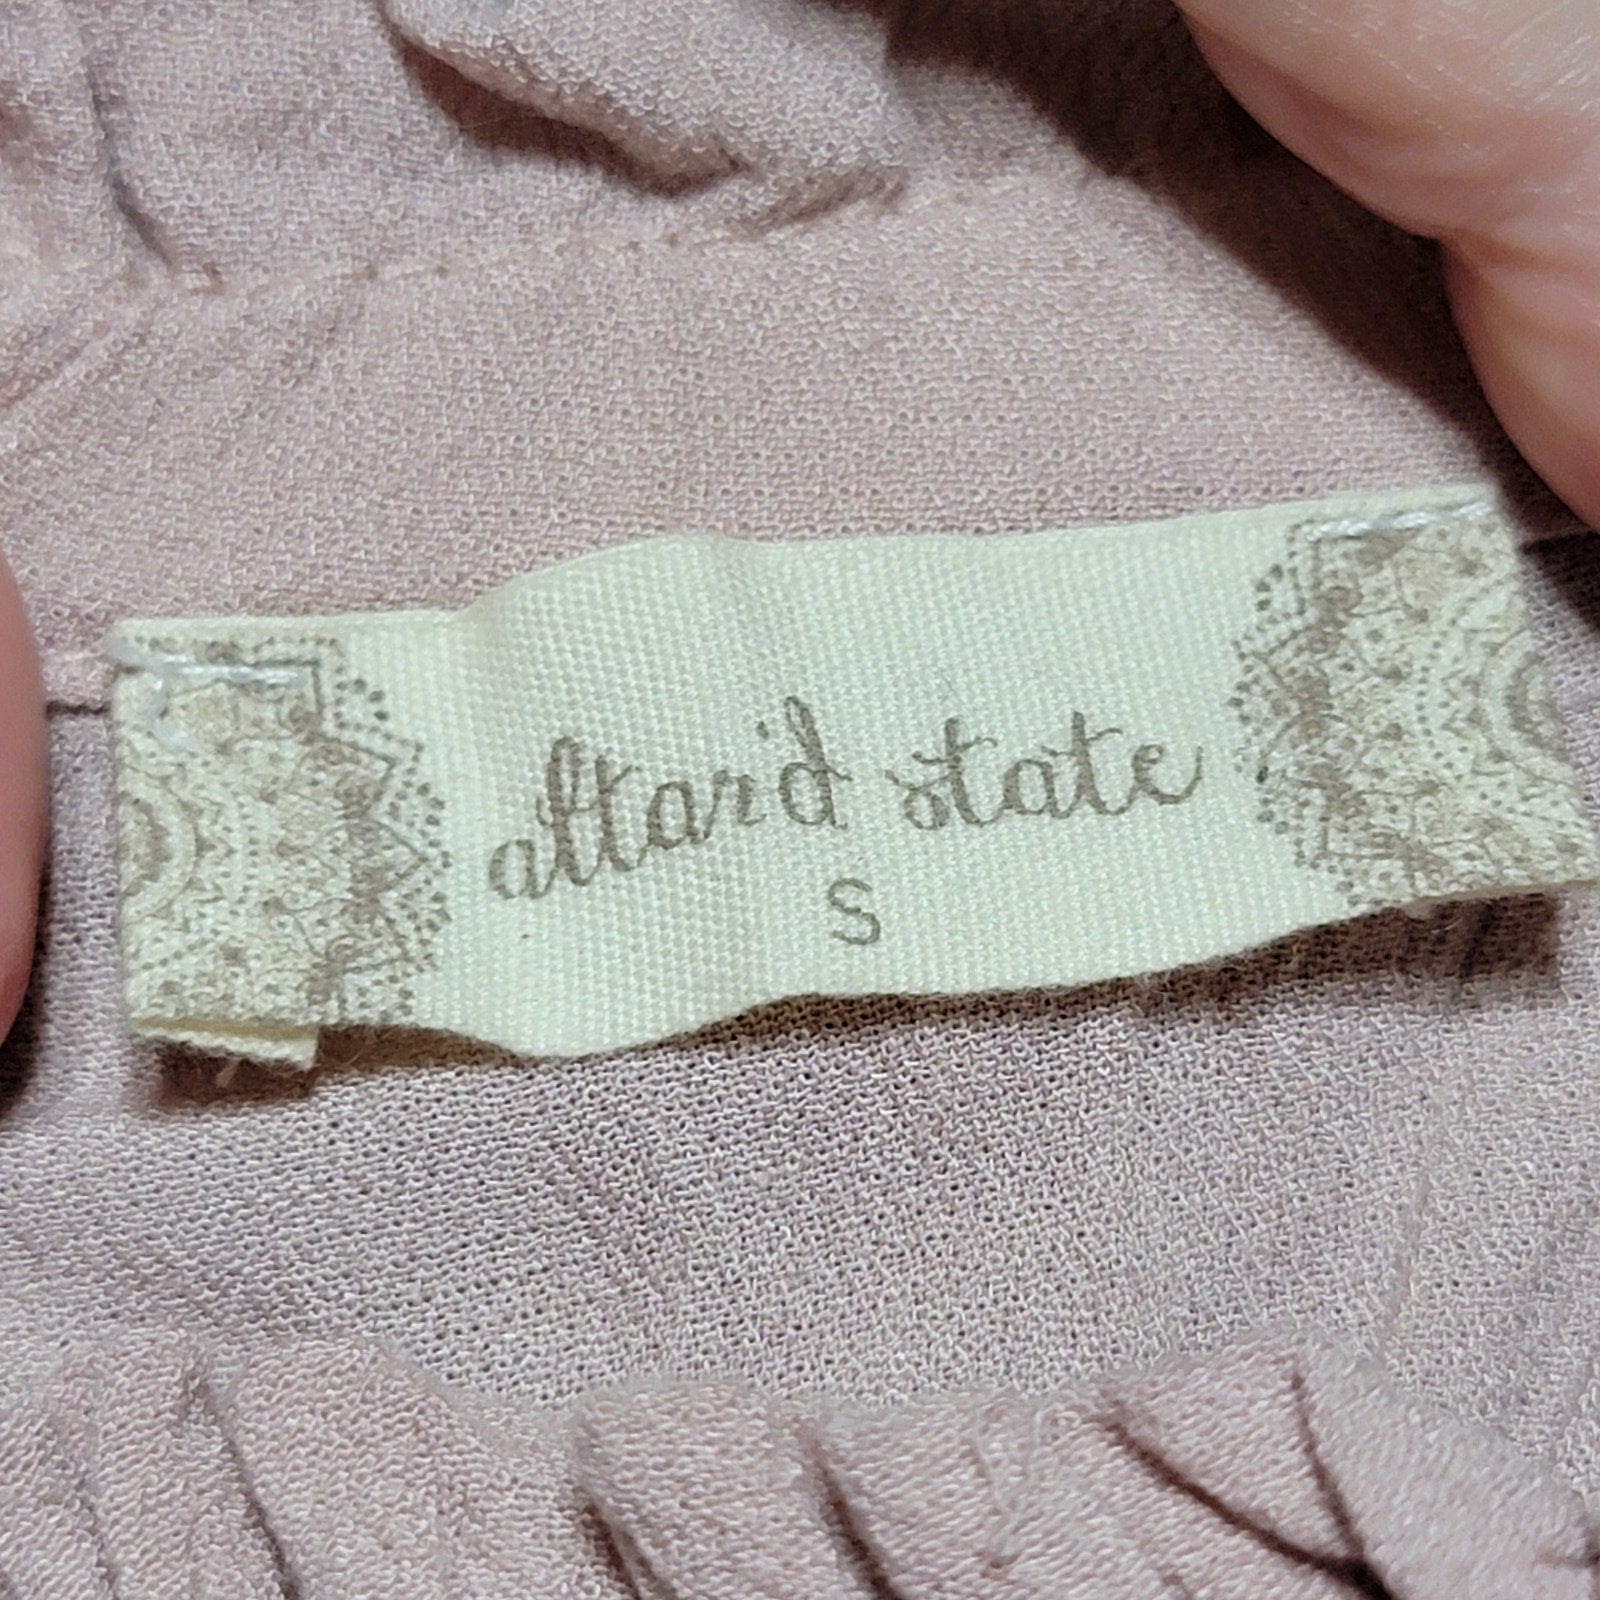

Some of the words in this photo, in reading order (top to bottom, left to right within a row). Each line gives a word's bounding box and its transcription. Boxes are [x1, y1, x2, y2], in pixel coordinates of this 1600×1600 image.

[487, 696, 852, 901] altar'd
[886, 711, 1203, 830] state
[827, 877, 882, 947] S
